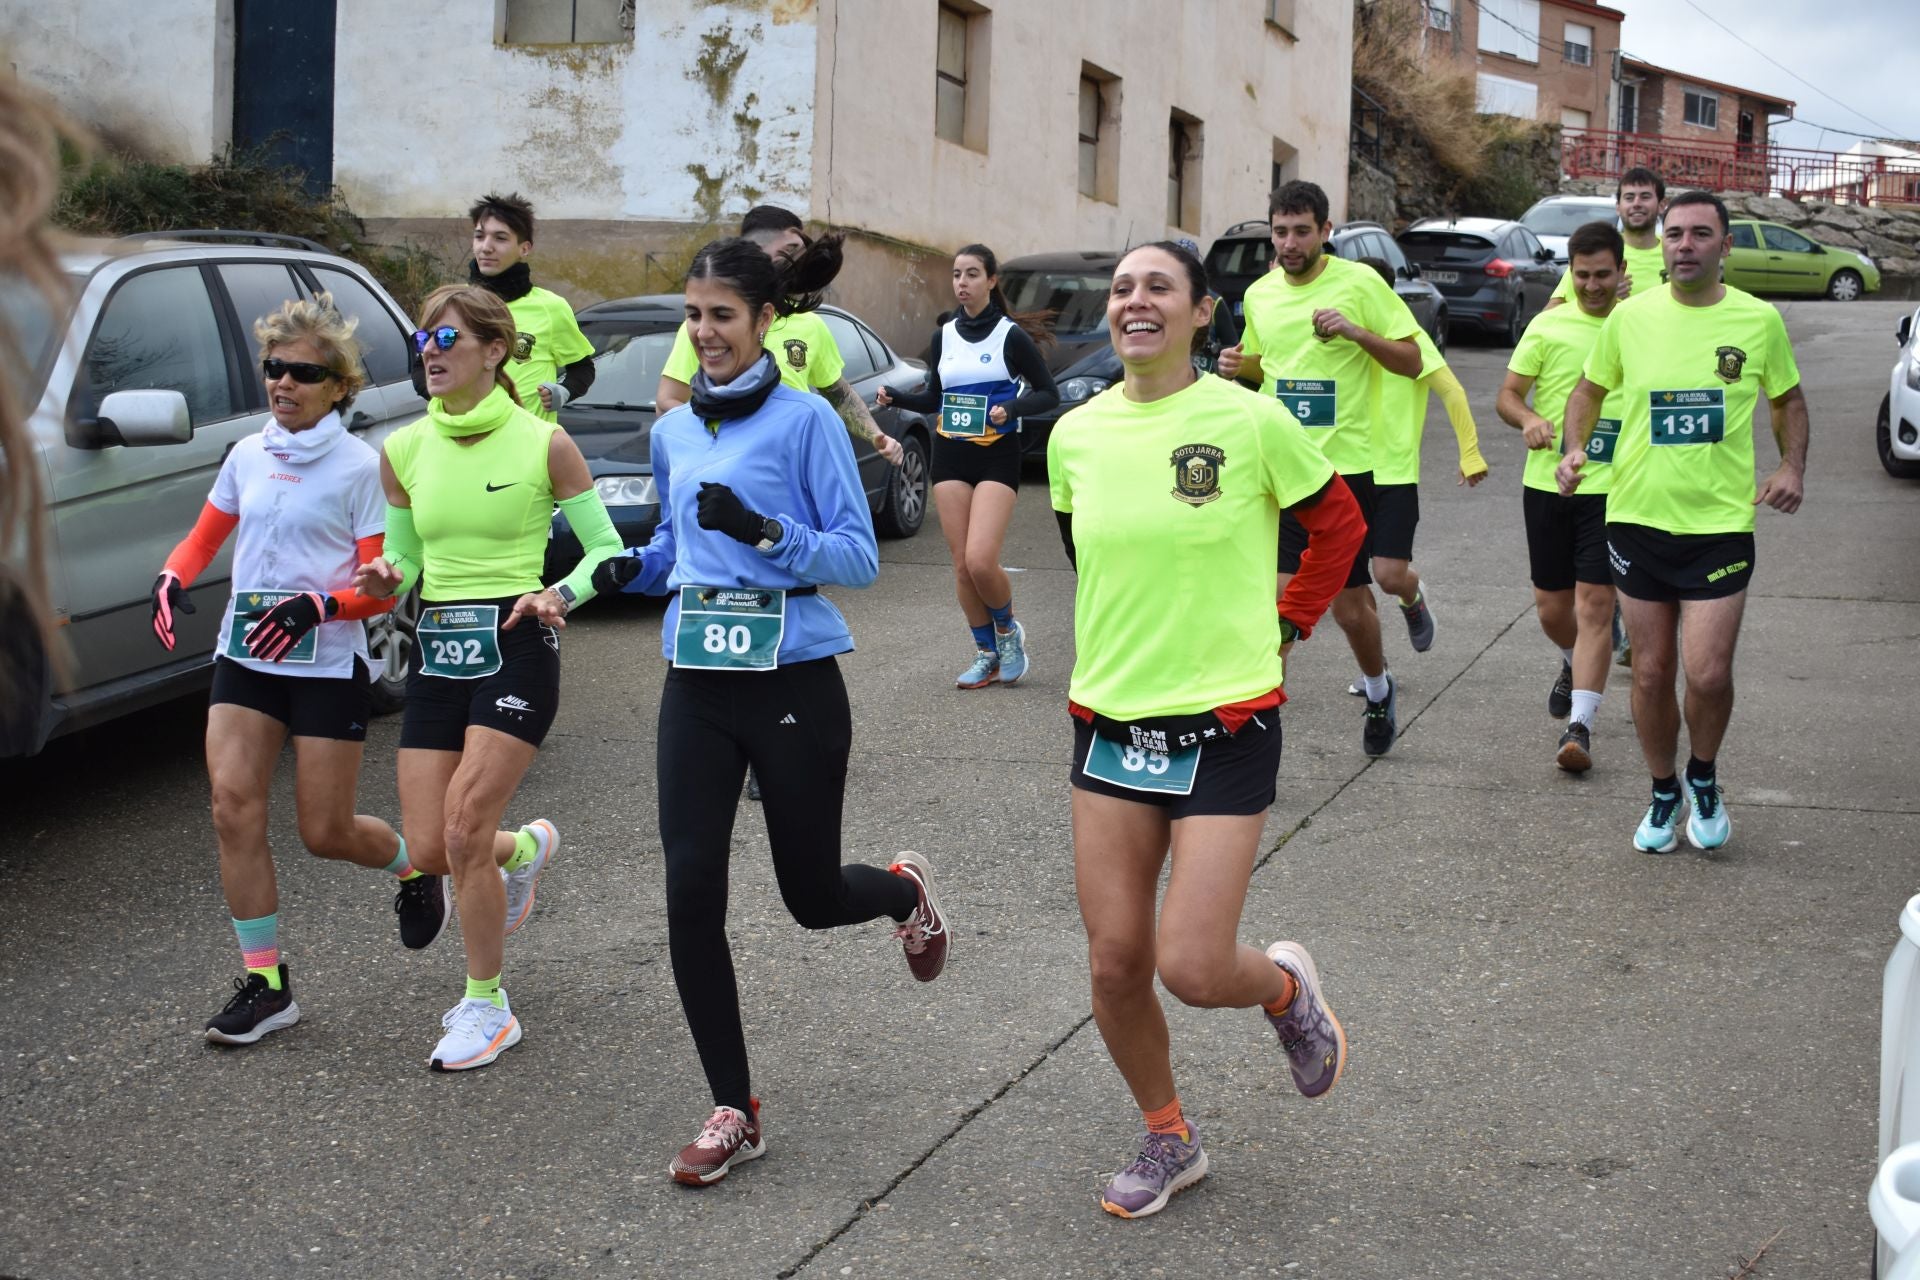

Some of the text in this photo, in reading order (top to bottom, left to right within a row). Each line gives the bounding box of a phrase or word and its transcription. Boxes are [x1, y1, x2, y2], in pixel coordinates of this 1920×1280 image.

[1297, 400, 1311, 418] 5
[951, 411, 971, 427] 99
[1662, 413, 1709, 435] 131
[1175, 445, 1222, 459] SOTO JARRA
[277, 473, 303, 483] TERREX
[1191, 468, 1203, 483] SJ
[718, 592, 734, 600] CAJA
[450, 616, 480, 624] NAVARRA
[703, 623, 751, 654] 80
[431, 639, 485, 665] 292
[504, 695, 530, 708] NIKE
[1122, 744, 1170, 775] 85
